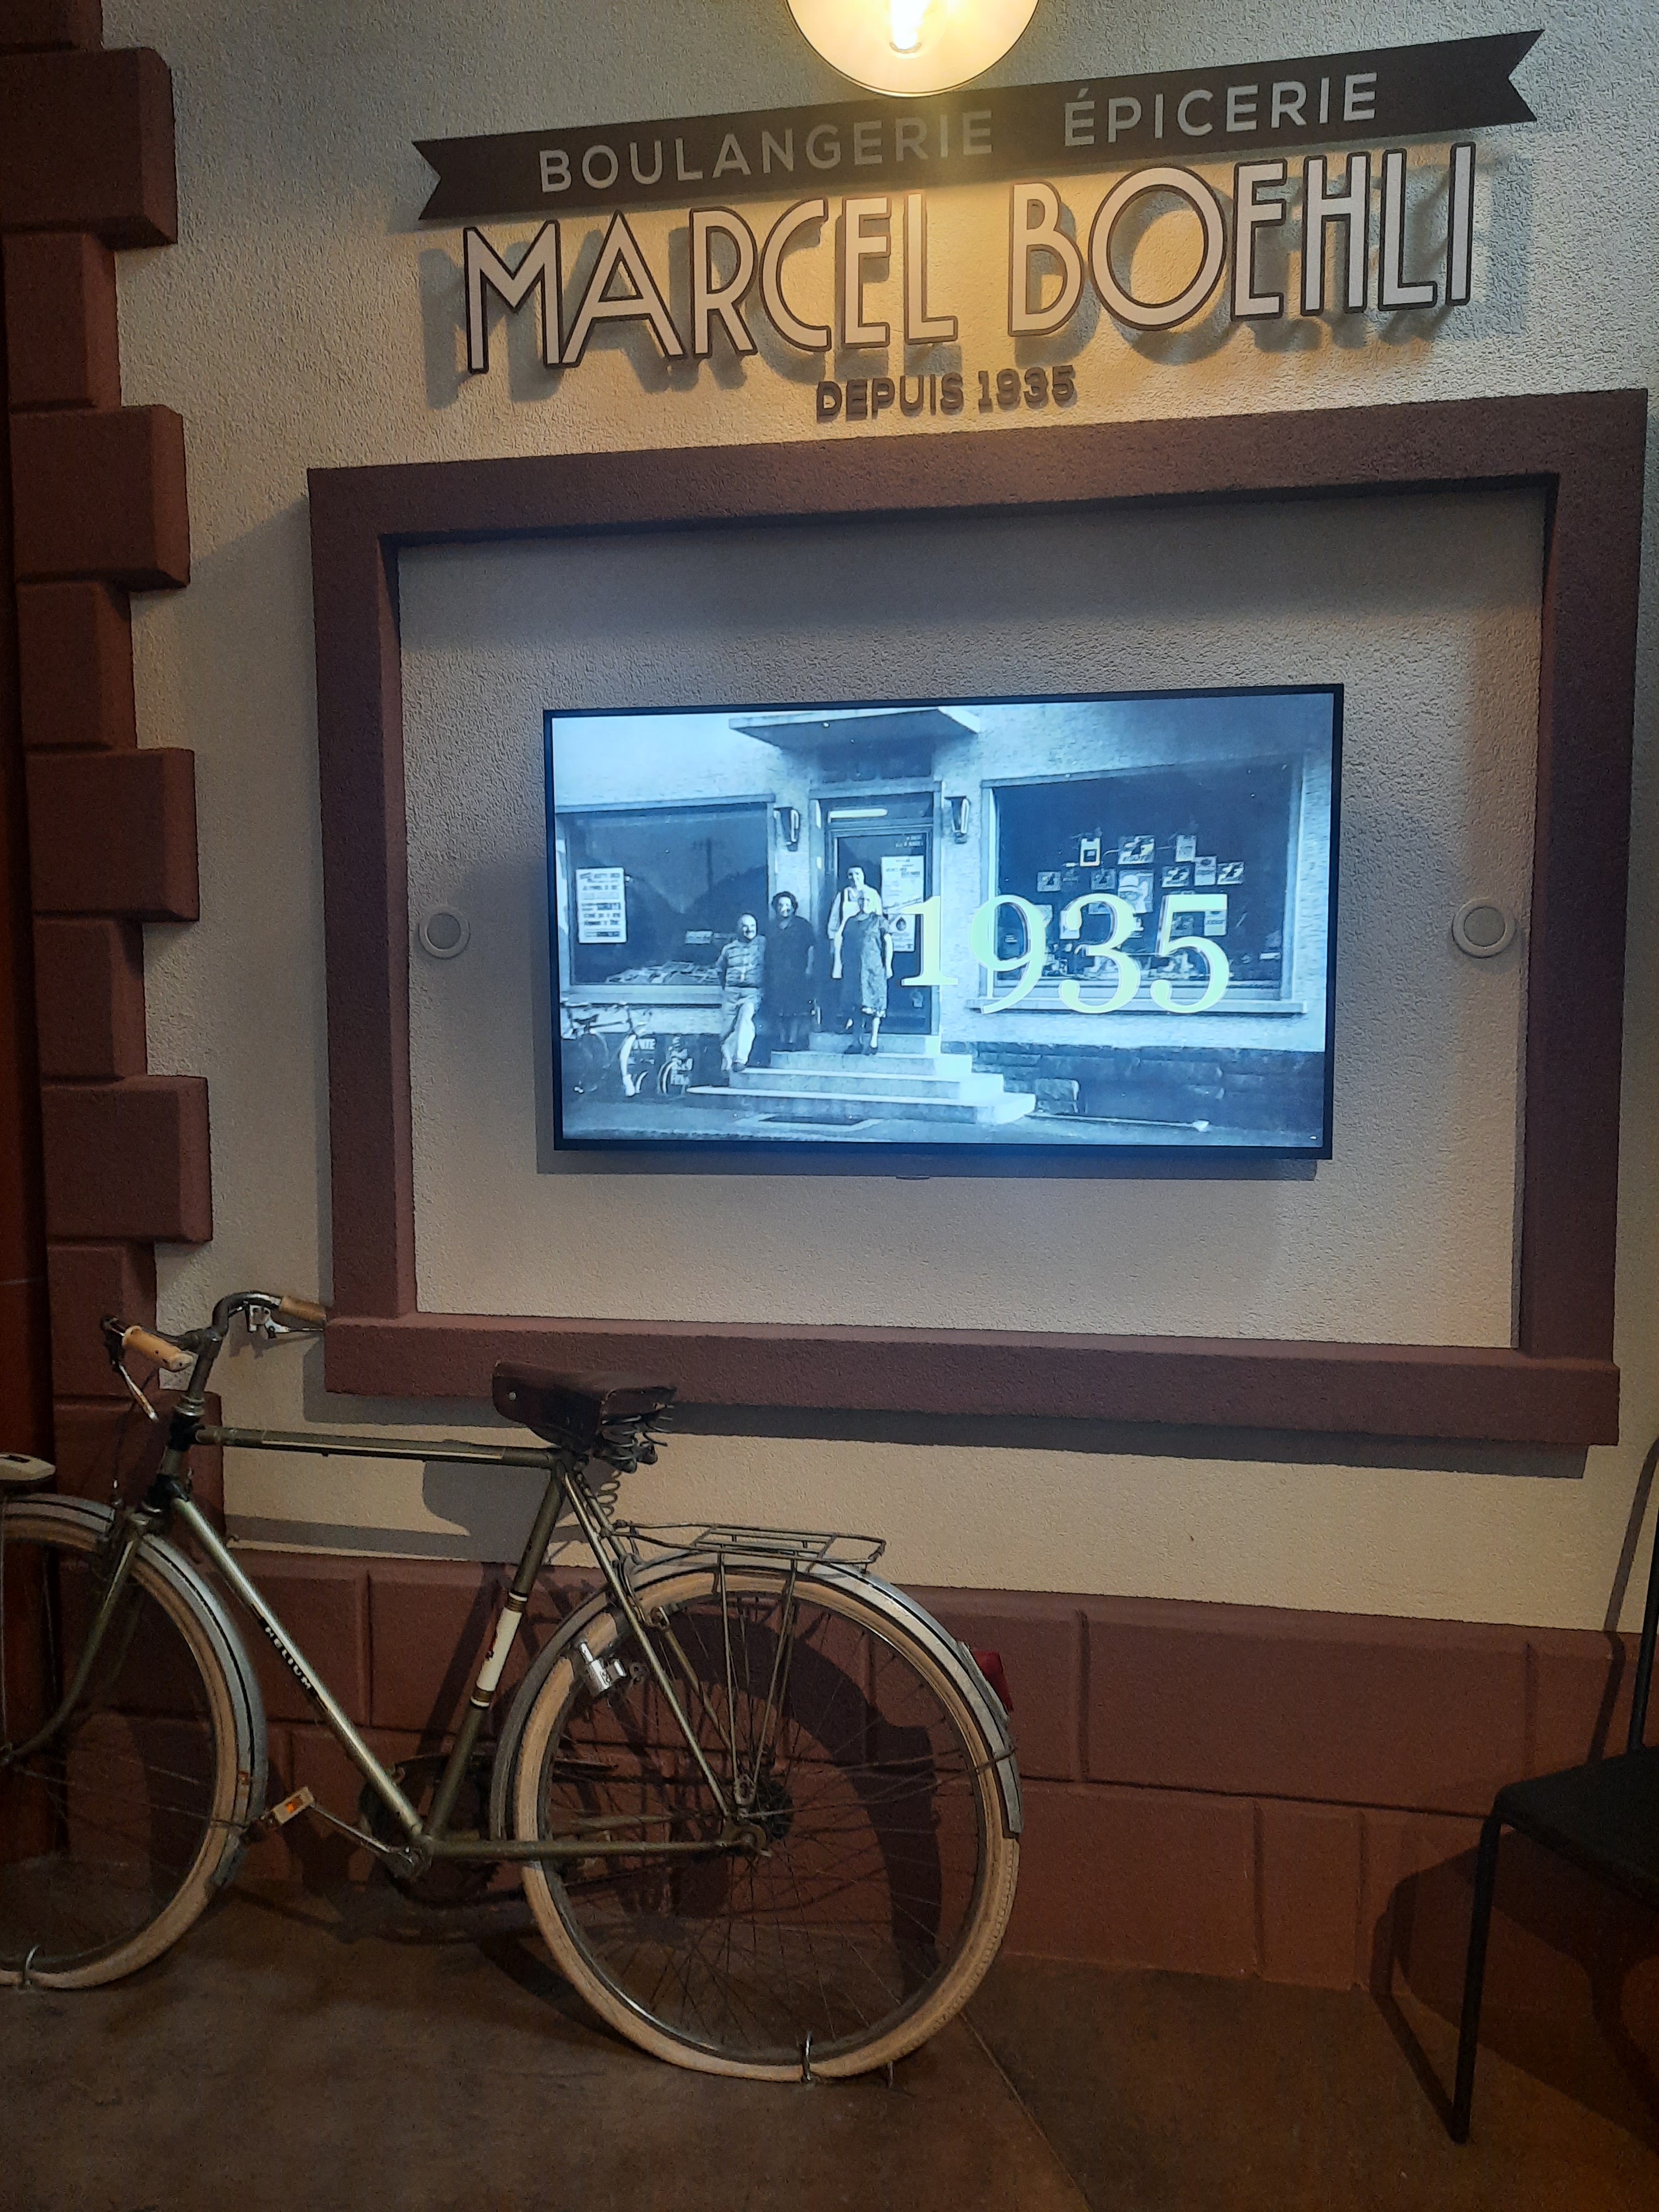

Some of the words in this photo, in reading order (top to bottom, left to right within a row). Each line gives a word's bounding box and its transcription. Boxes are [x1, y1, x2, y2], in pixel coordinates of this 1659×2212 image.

[539, 110, 993, 193] BOULANGERIE
[1065, 72, 1378, 146] ÉPICERIE
[463, 192, 958, 373] MARCEL
[1008, 142, 1475, 336] BOEHLI
[816, 372, 964, 422] DEPUIS
[977, 365, 1077, 414] 1935
[901, 894, 1229, 1014] 1935
